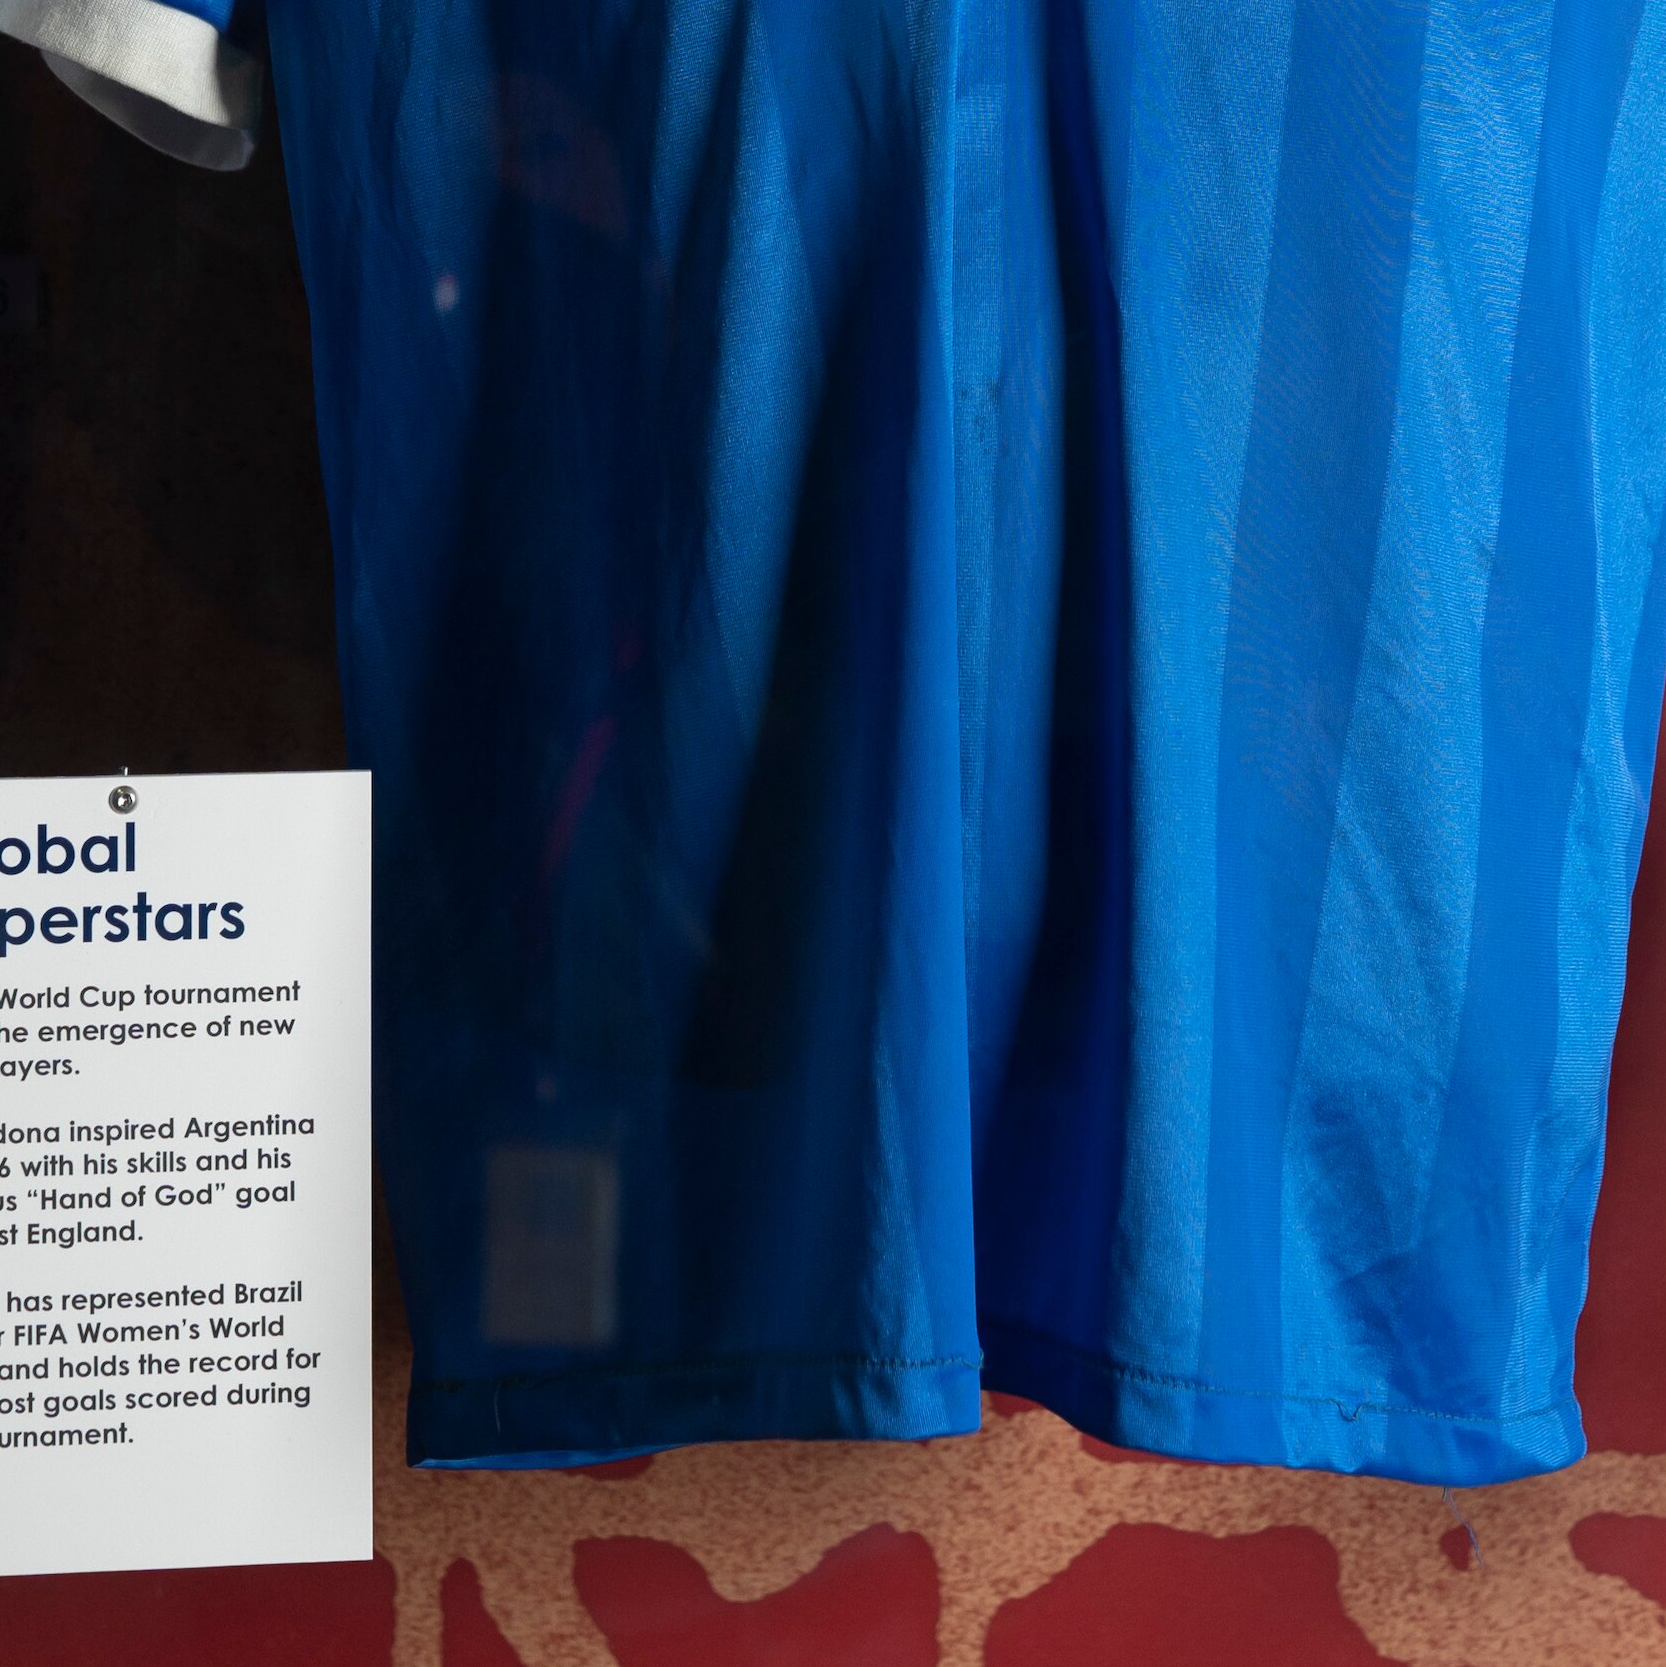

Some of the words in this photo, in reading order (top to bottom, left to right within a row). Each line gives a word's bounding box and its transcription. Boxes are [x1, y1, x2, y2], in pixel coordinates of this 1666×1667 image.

[79, 985, 135, 1012] Cup
[144, 980, 301, 1006] tournament
[38, 1021, 197, 1046] emergence
[206, 1015, 232, 1037] of
[240, 1018, 296, 1036] new
[69, 1117, 174, 1146] inspired
[184, 1113, 314, 1143] Argentina
[20, 1154, 74, 1177] with
[84, 1153, 118, 1175] his
[127, 1151, 187, 1174] skills
[196, 1148, 247, 1172] and
[257, 1147, 292, 1169] his
[27, 1186, 111, 1210] “Hand
[121, 1185, 146, 1208] of
[155, 1182, 225, 1206] God”
[235, 1180, 295, 1209] goal
[27, 1219, 143, 1249] England.
[7, 1291, 53, 1313] has
[62, 1283, 224, 1315] represented
[235, 1280, 302, 1304] Brazil
[14, 1323, 68, 1346] FIFA
[77, 1318, 200, 1344] Women’s
[209, 1315, 284, 1339] World
[59, 1355, 130, 1378] holds
[138, 1353, 180, 1375] the
[189, 1348, 278, 1373] record
[286, 1347, 321, 1370] for
[43, 1389, 116, 1418] goals
[125, 1384, 217, 1410] scored
[226, 1382, 310, 1408] during
